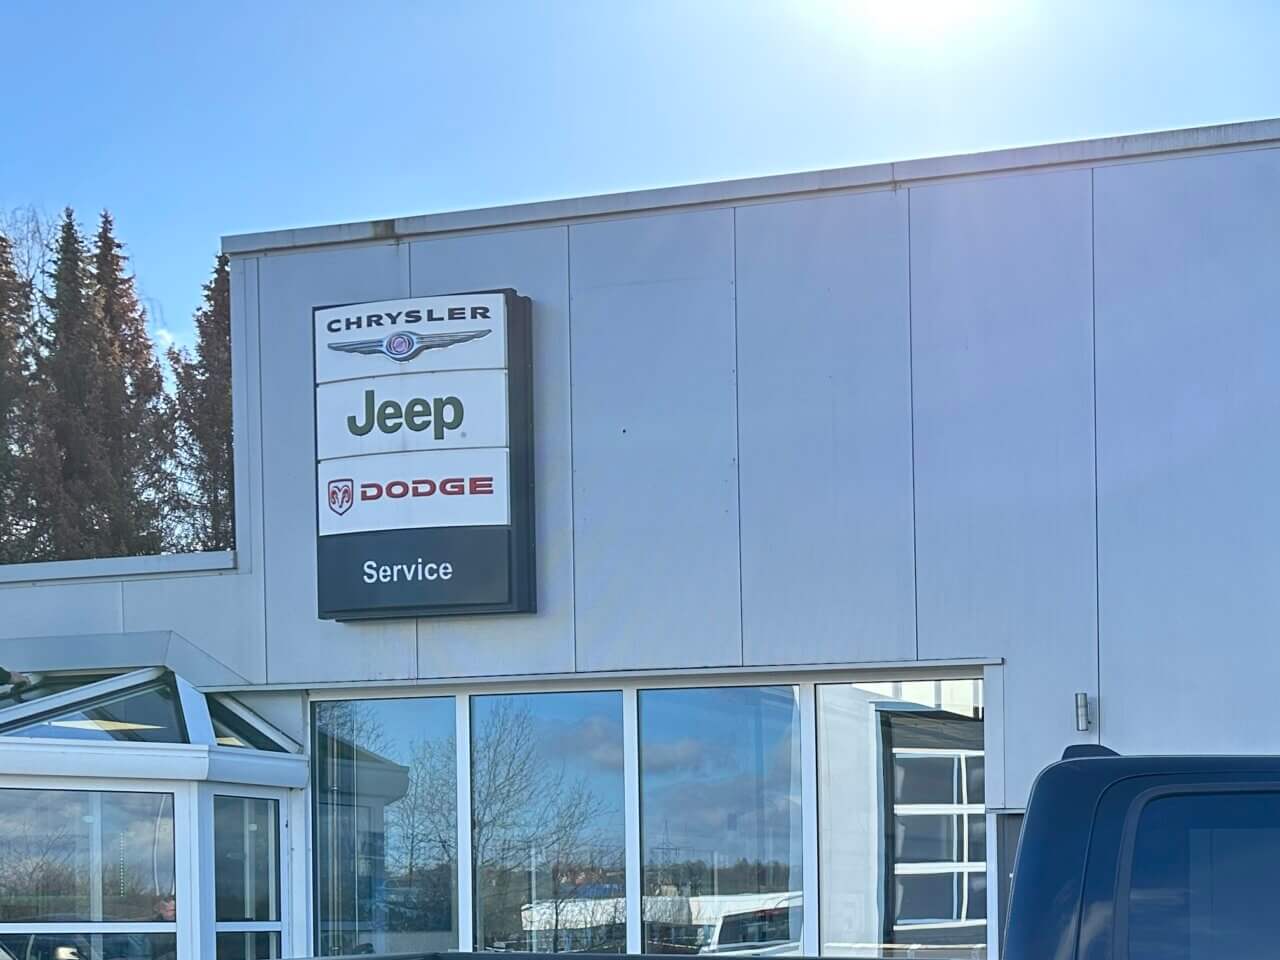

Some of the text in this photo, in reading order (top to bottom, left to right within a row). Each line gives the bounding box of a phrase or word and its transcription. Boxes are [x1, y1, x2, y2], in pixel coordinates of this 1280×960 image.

[327, 306, 491, 333] CHRYSLER
[347, 389, 465, 441] Jeep
[360, 477, 494, 501] DODGE
[363, 558, 453, 583] Service
